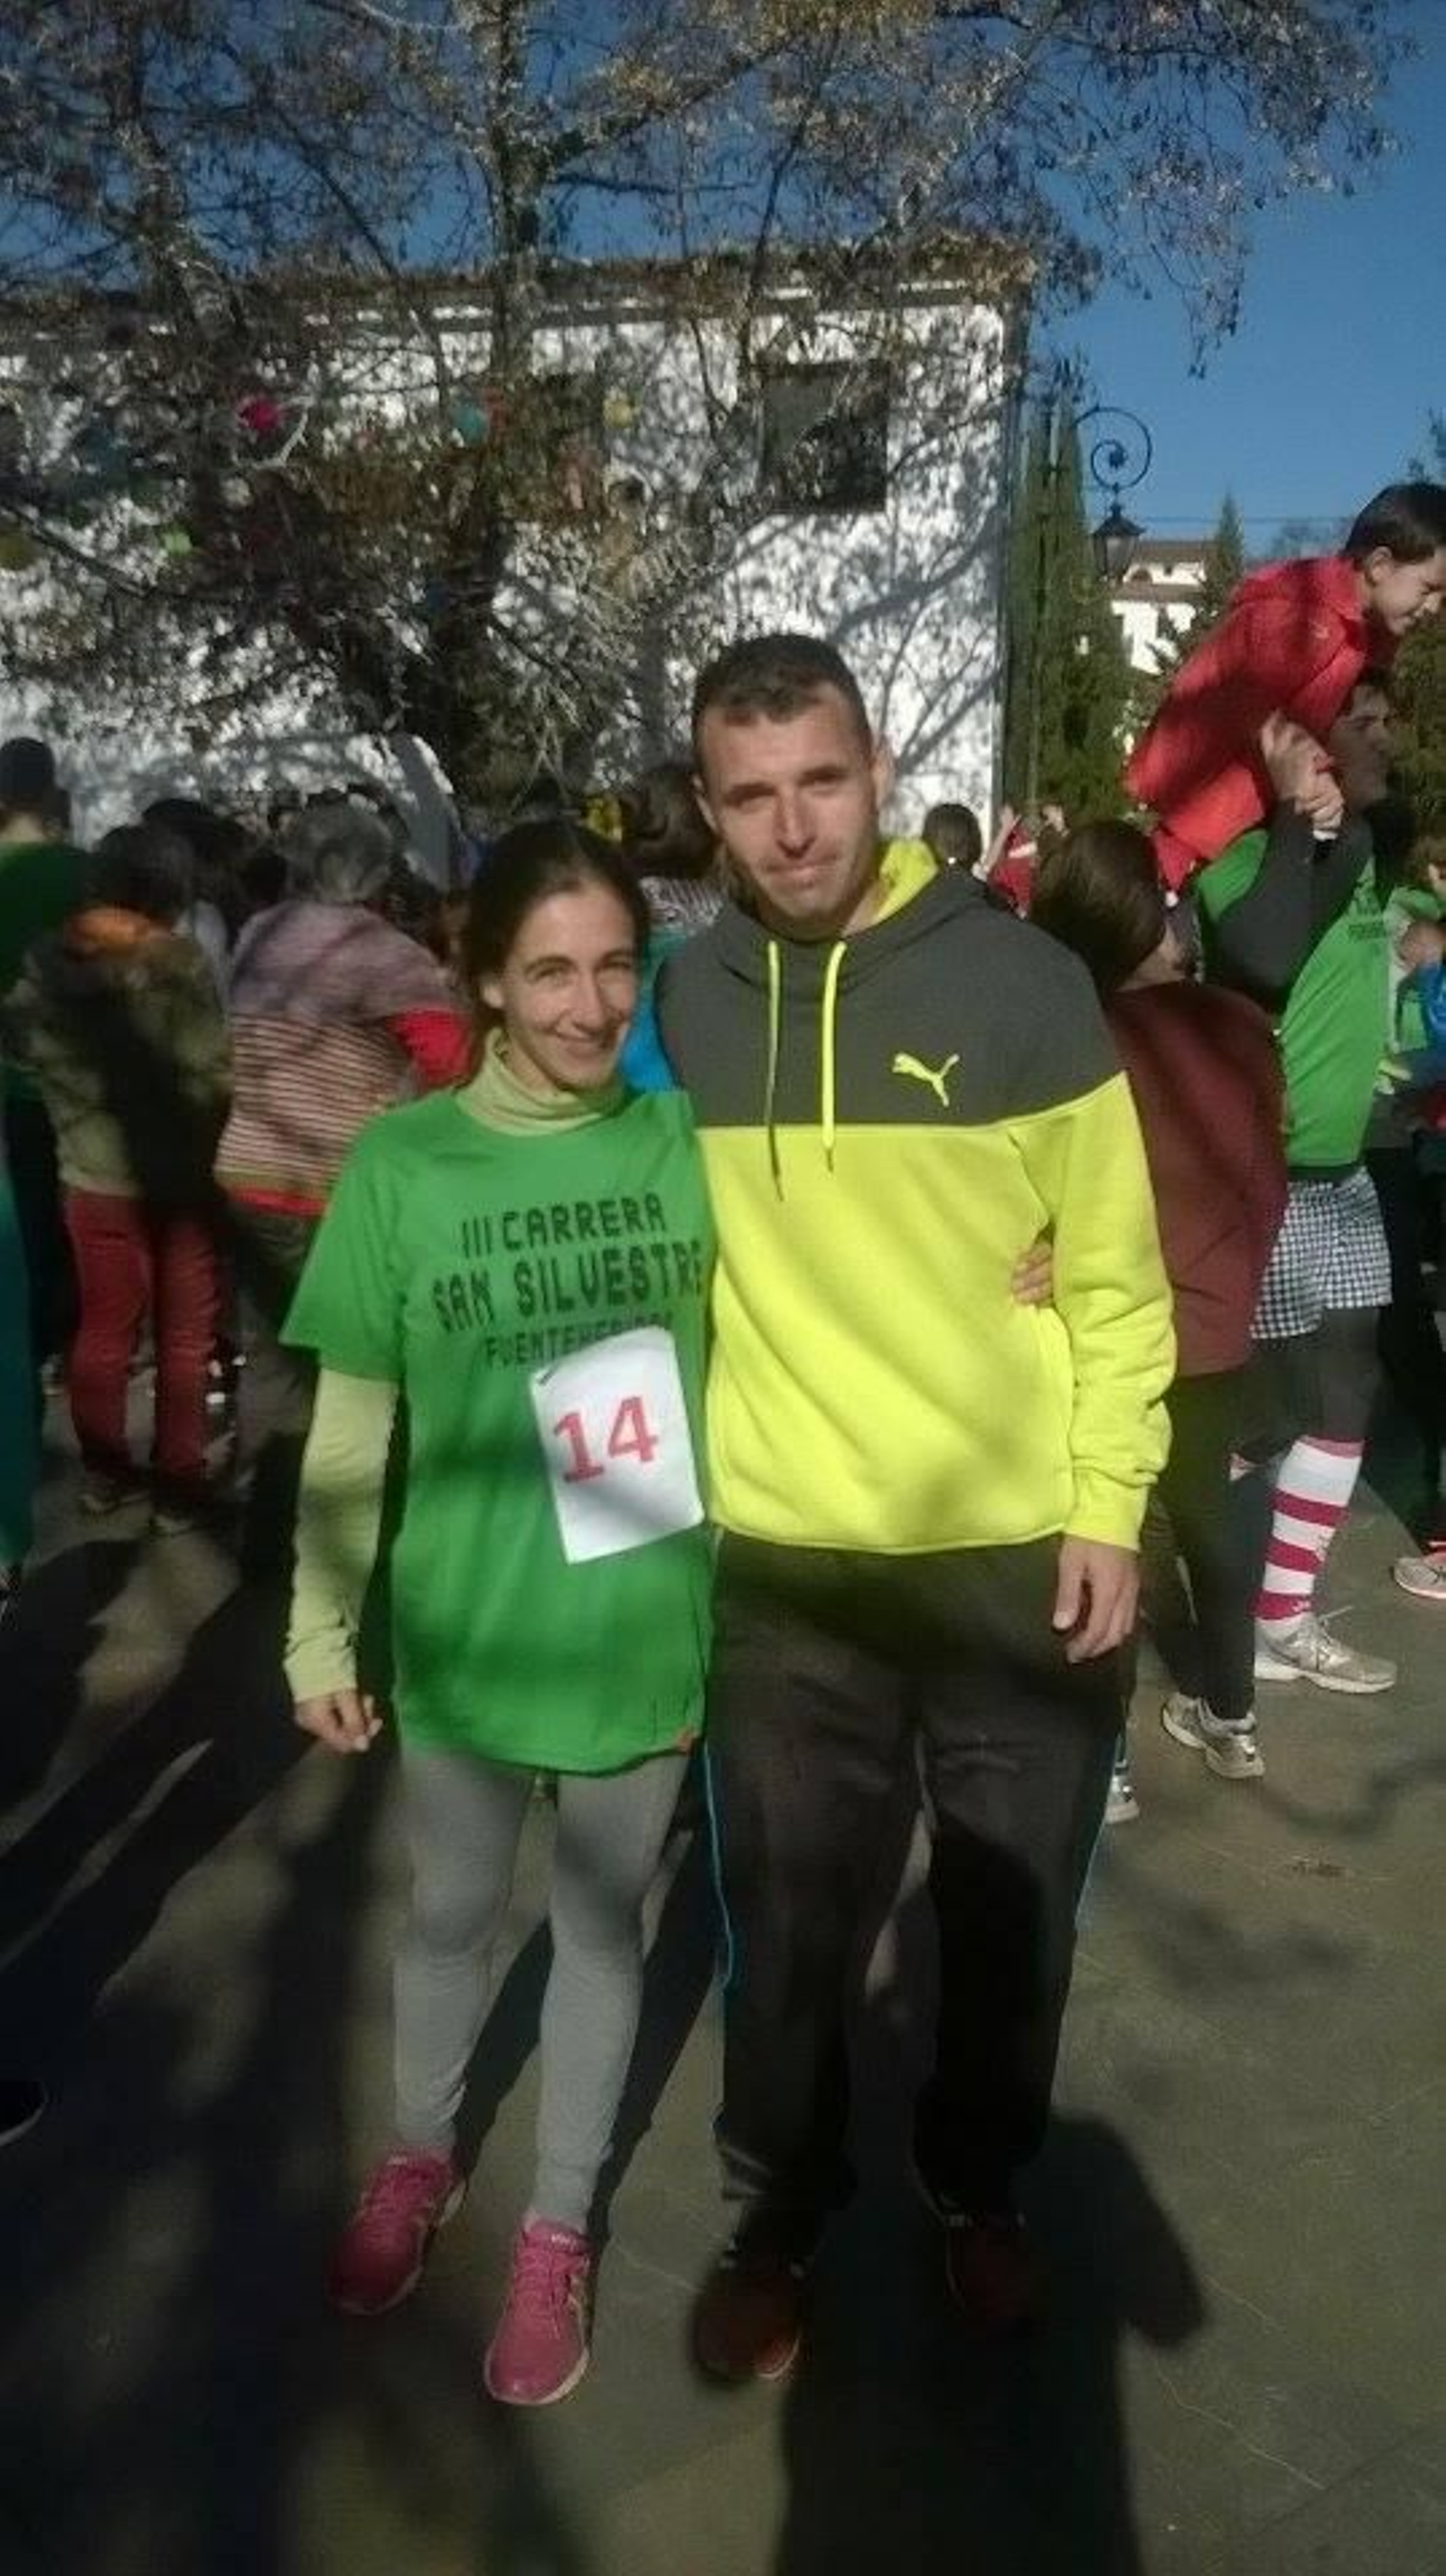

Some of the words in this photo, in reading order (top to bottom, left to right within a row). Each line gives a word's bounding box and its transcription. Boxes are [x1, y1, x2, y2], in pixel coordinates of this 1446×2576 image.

[461, 1217, 493, 1258] III
[502, 1192, 667, 1252] CARRERA
[431, 1269, 494, 1333] SAN
[553, 1396, 659, 1483] 14
